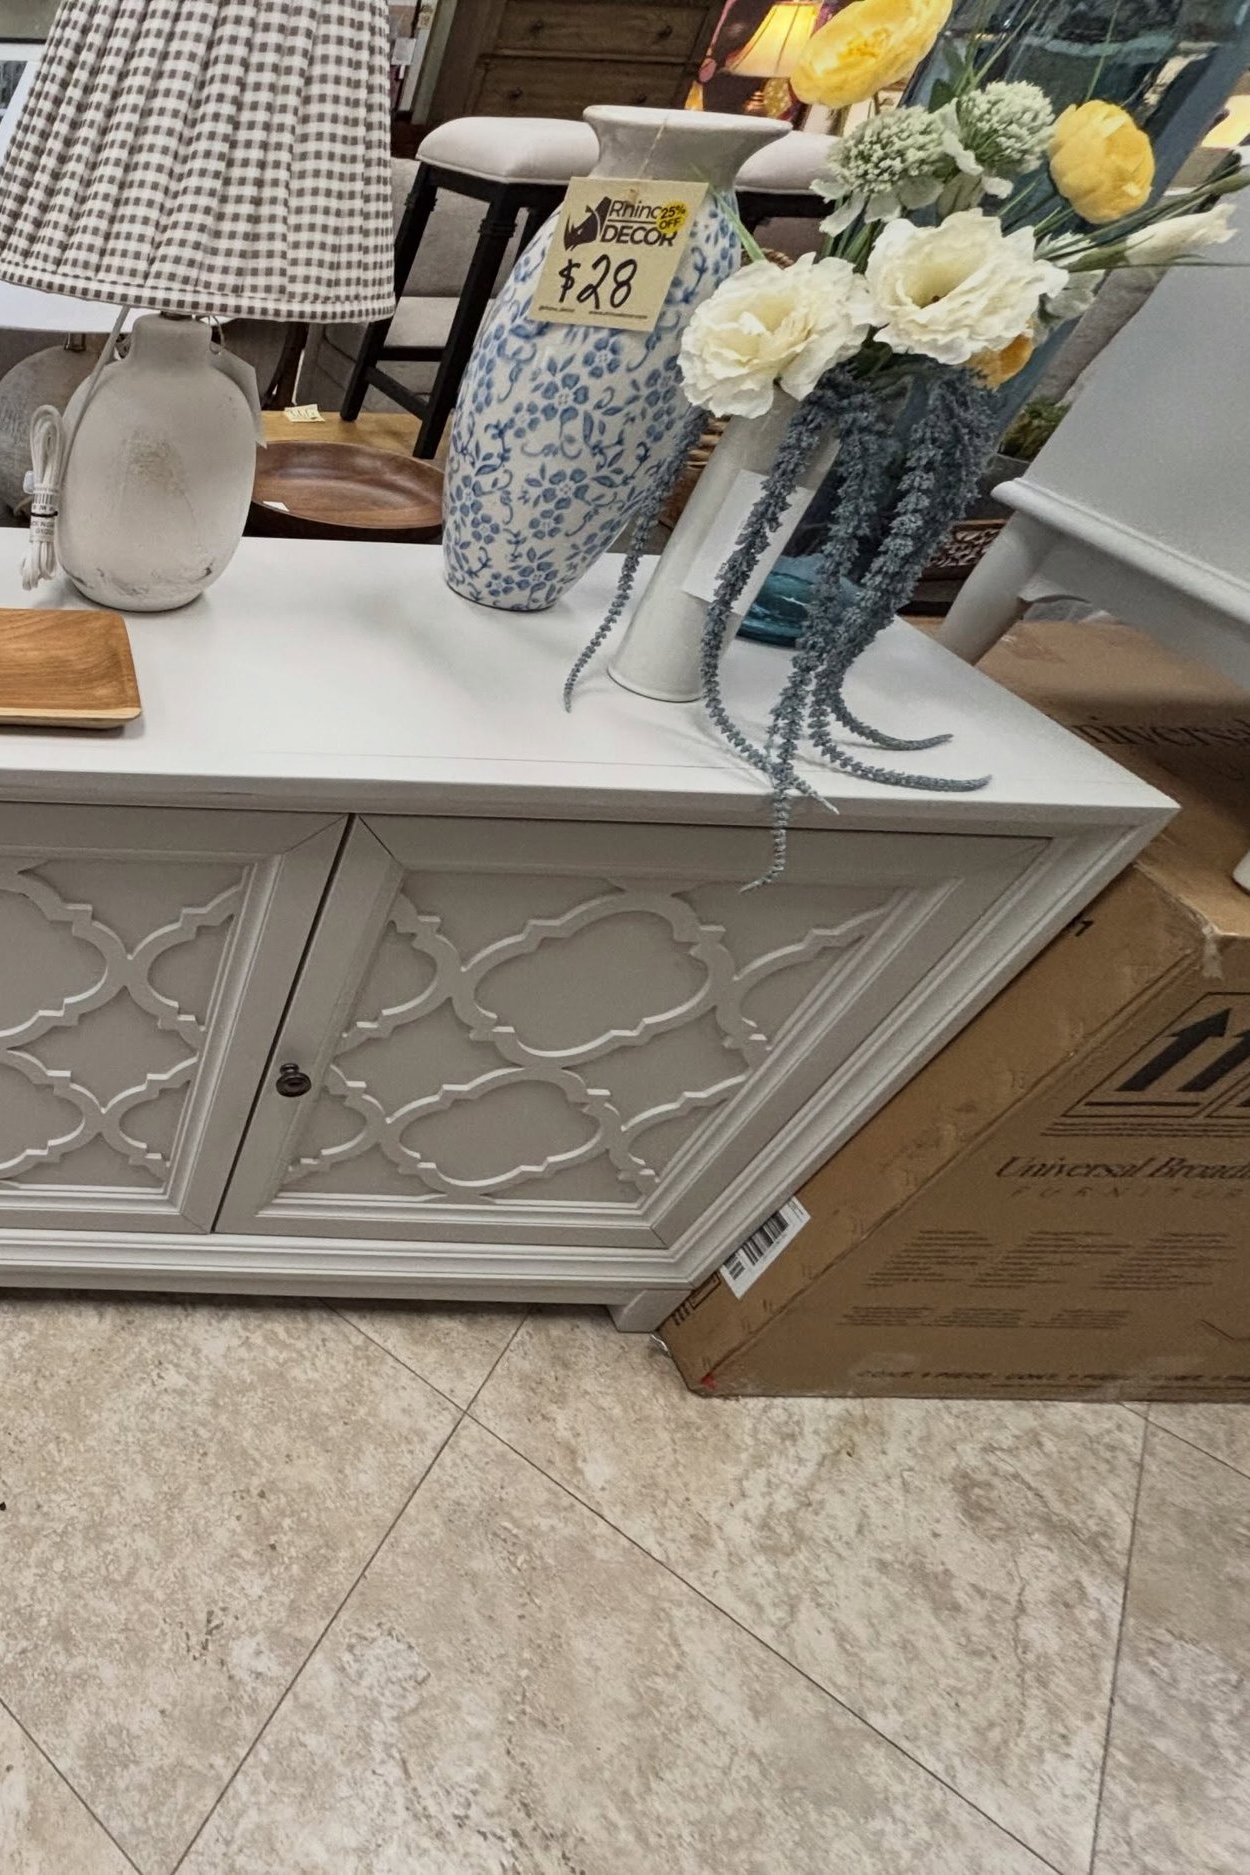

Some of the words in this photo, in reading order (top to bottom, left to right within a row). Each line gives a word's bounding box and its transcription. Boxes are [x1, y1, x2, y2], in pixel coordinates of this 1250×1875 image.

[609, 200, 662, 219] Rhino
[660, 204, 687, 219] 25%
[658, 217, 681, 230] OFF
[600, 224, 679, 247] DECOR
[558, 253, 638, 309] $28
[996, 1156, 1156, 1178] Universal
